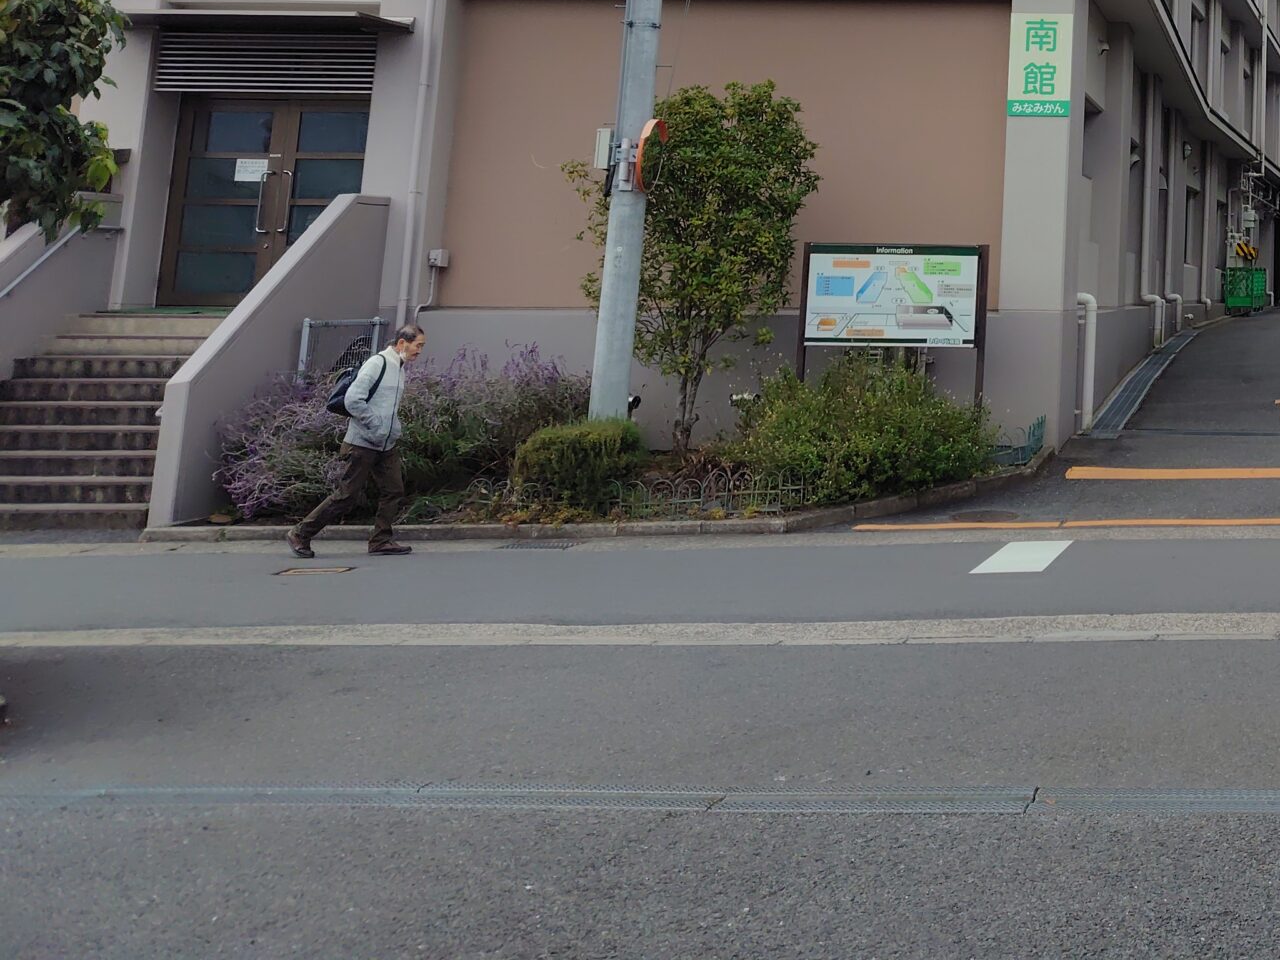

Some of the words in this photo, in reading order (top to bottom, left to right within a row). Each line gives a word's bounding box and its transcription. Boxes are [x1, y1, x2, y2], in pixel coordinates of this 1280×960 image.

[1022, 18, 1059, 96] 南館
[1011, 102, 1065, 114] みなみかん
[876, 246, 914, 255] Information
